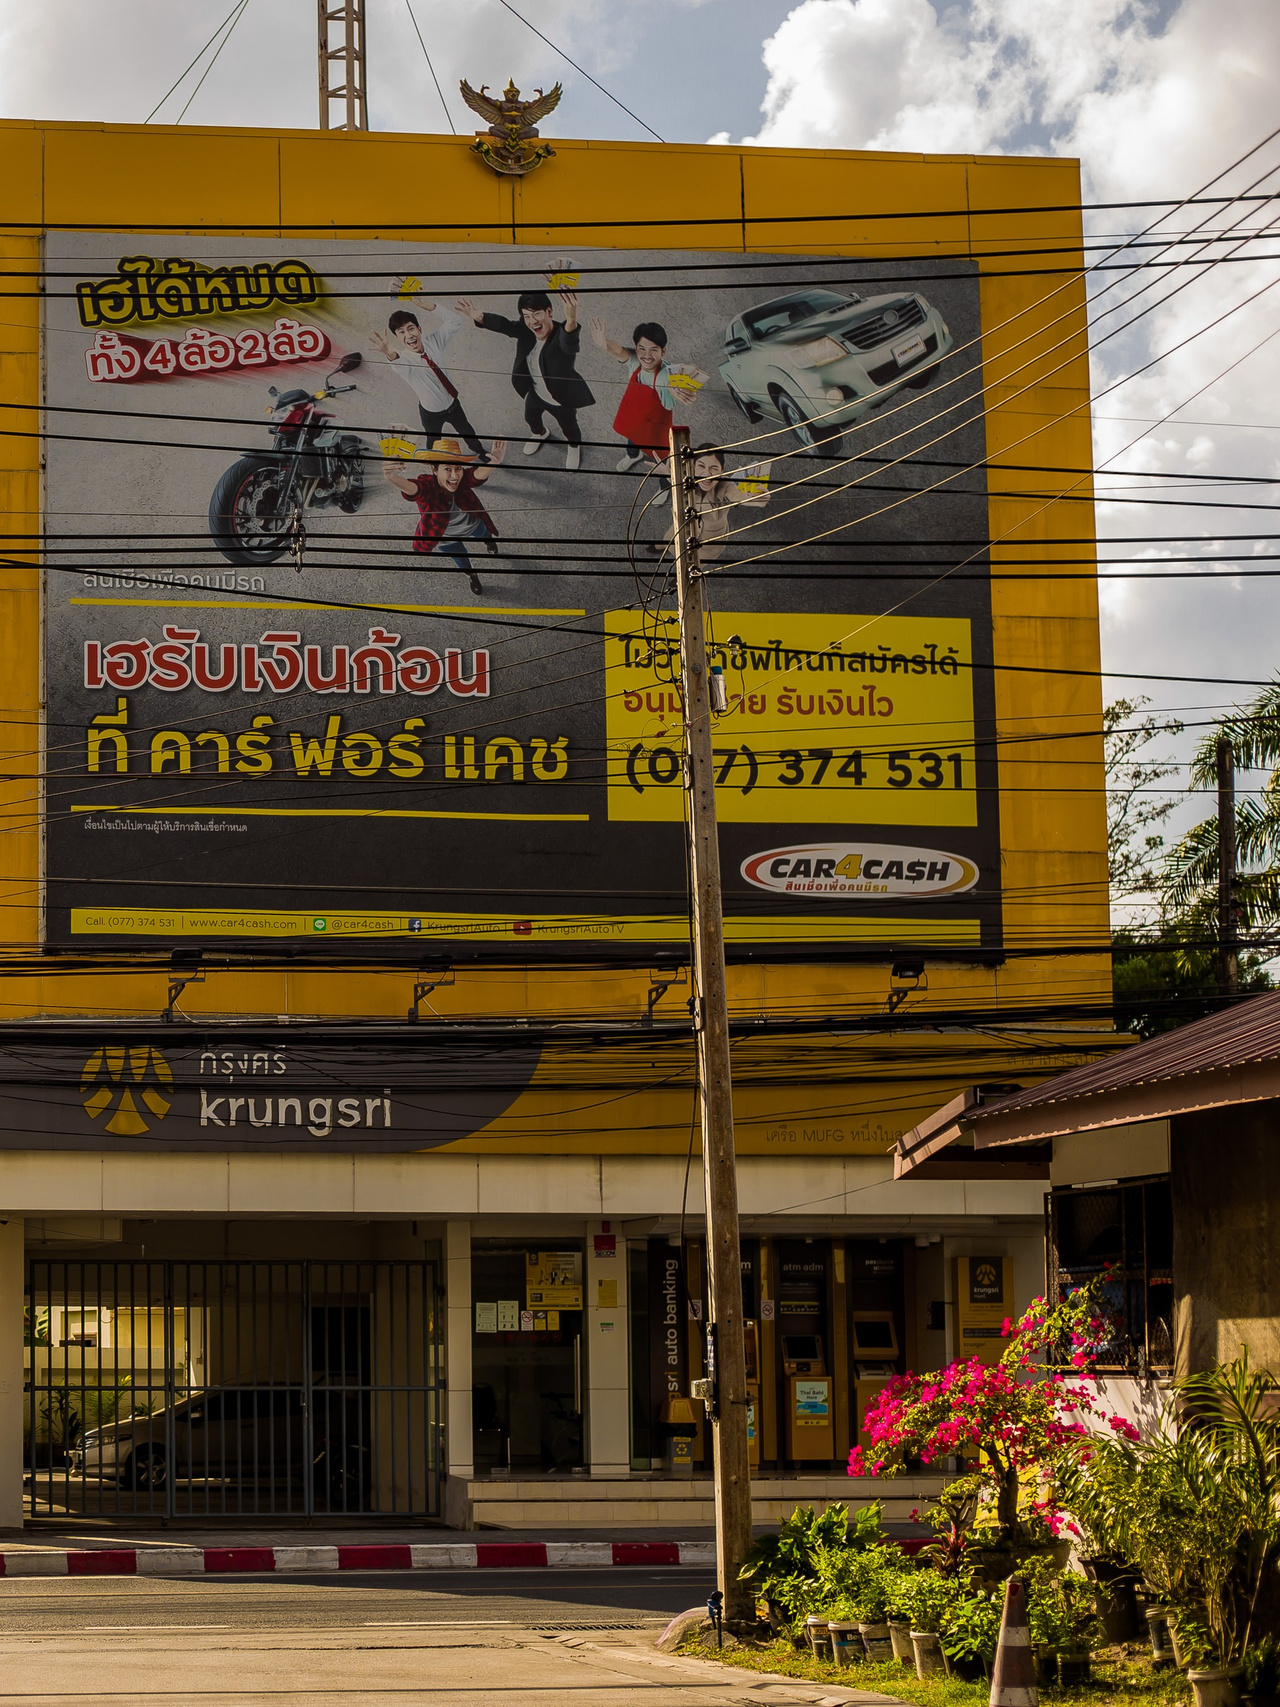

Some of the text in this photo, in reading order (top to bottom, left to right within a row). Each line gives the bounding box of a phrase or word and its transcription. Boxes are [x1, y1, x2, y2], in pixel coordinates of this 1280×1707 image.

[76, 255, 320, 327] เฮได้หมด
[84, 625, 491, 697] เฮรับเงินก้อน
[777, 685, 893, 716] รับเงินไว
[88, 697, 569, 781] ที่ คาร์ ฟอร์ แคช
[626, 743, 962, 795] (07) 374 531
[108, 916, 135, 929] (077)
[138, 917, 156, 927] 374
[159, 918, 175, 927] 531
[189, 917, 298, 930] www.car4cash.com
[331, 919, 395, 931] @car4cash
[200, 1087, 391, 1138] krungsri
[765, 1124, 797, 1143] เครือ
[803, 1129, 845, 1143] MUFG
[783, 1262, 824, 1271] atm adm
[663, 1259, 679, 1325] banking
[973, 1286, 999, 1295] krungsri
[664, 1328, 678, 1365] auto
